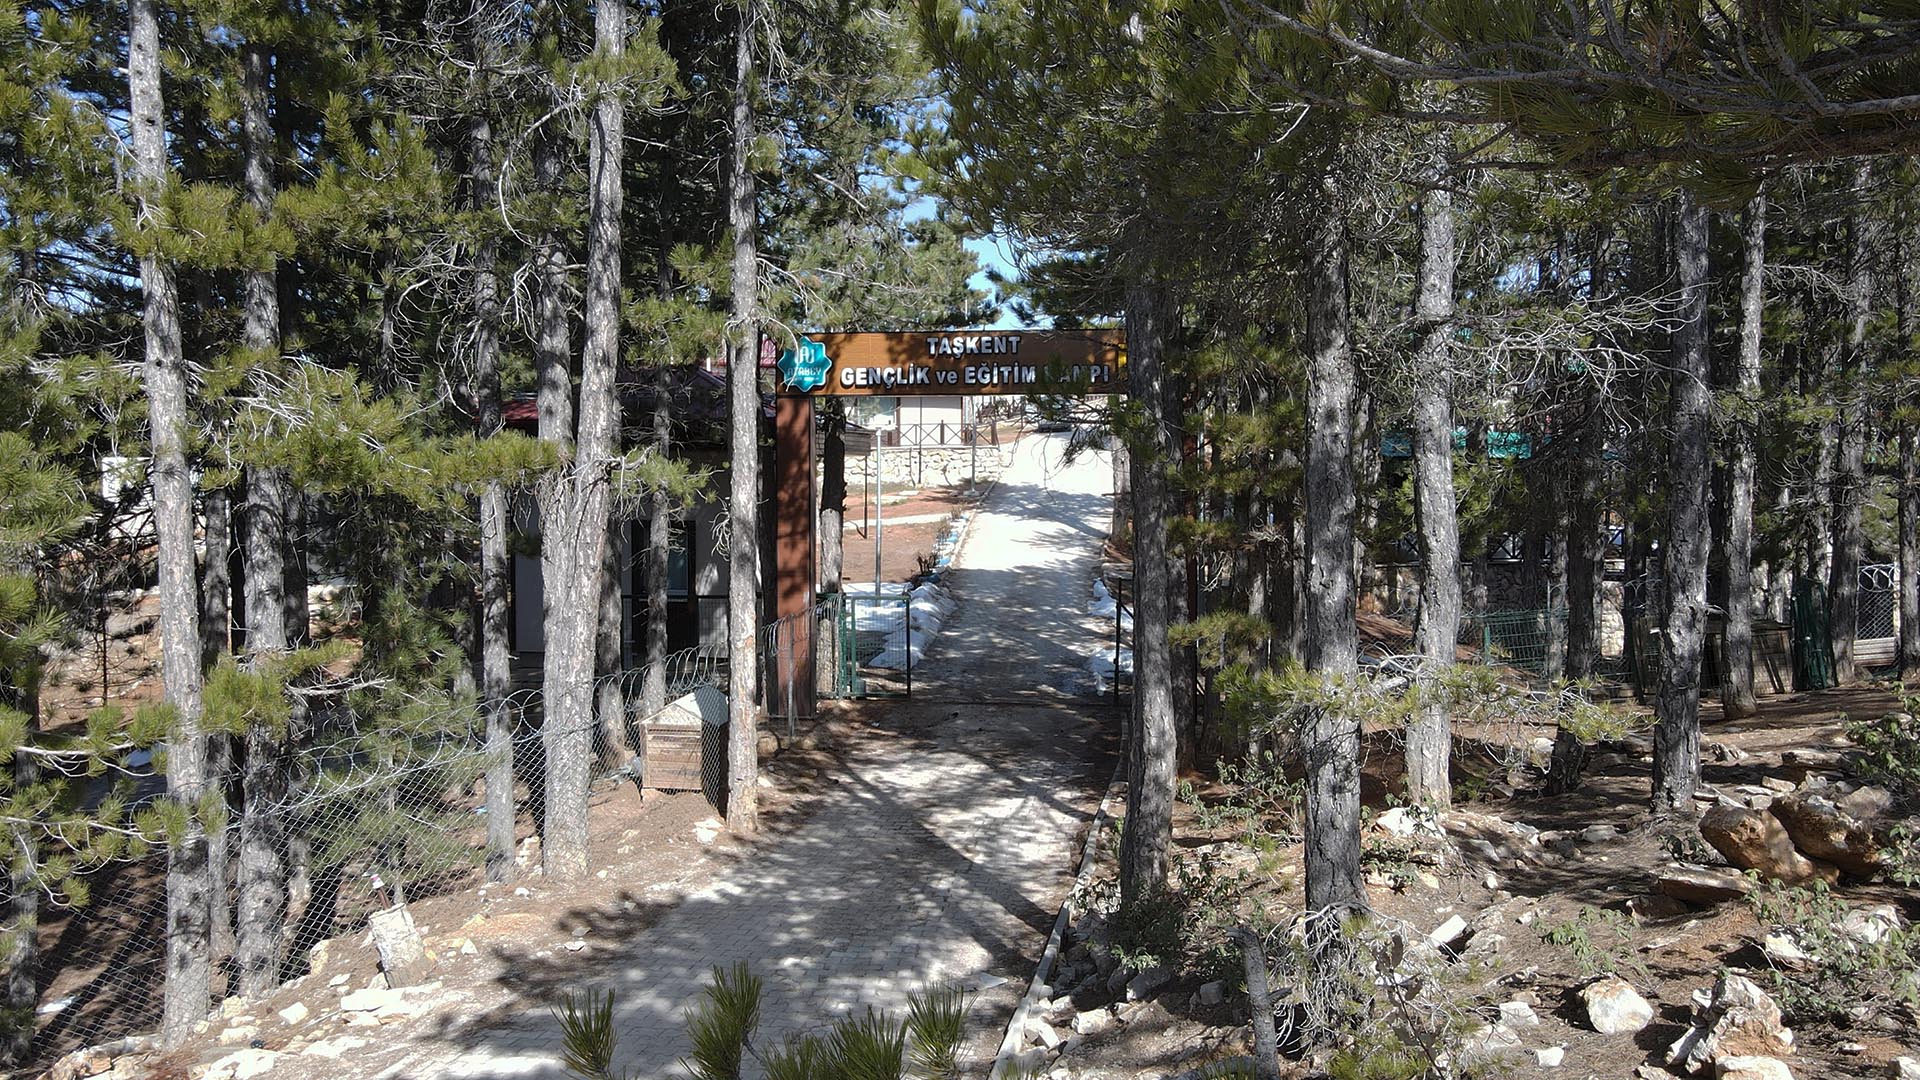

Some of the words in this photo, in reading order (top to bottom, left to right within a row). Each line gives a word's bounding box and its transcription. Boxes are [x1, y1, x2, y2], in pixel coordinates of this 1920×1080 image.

[927, 336, 1021, 358] TAŞKENT
[840, 363, 930, 387] GENÇLİK
[936, 370, 958, 384] ve
[964, 362, 1036, 384] EĞİTİM
